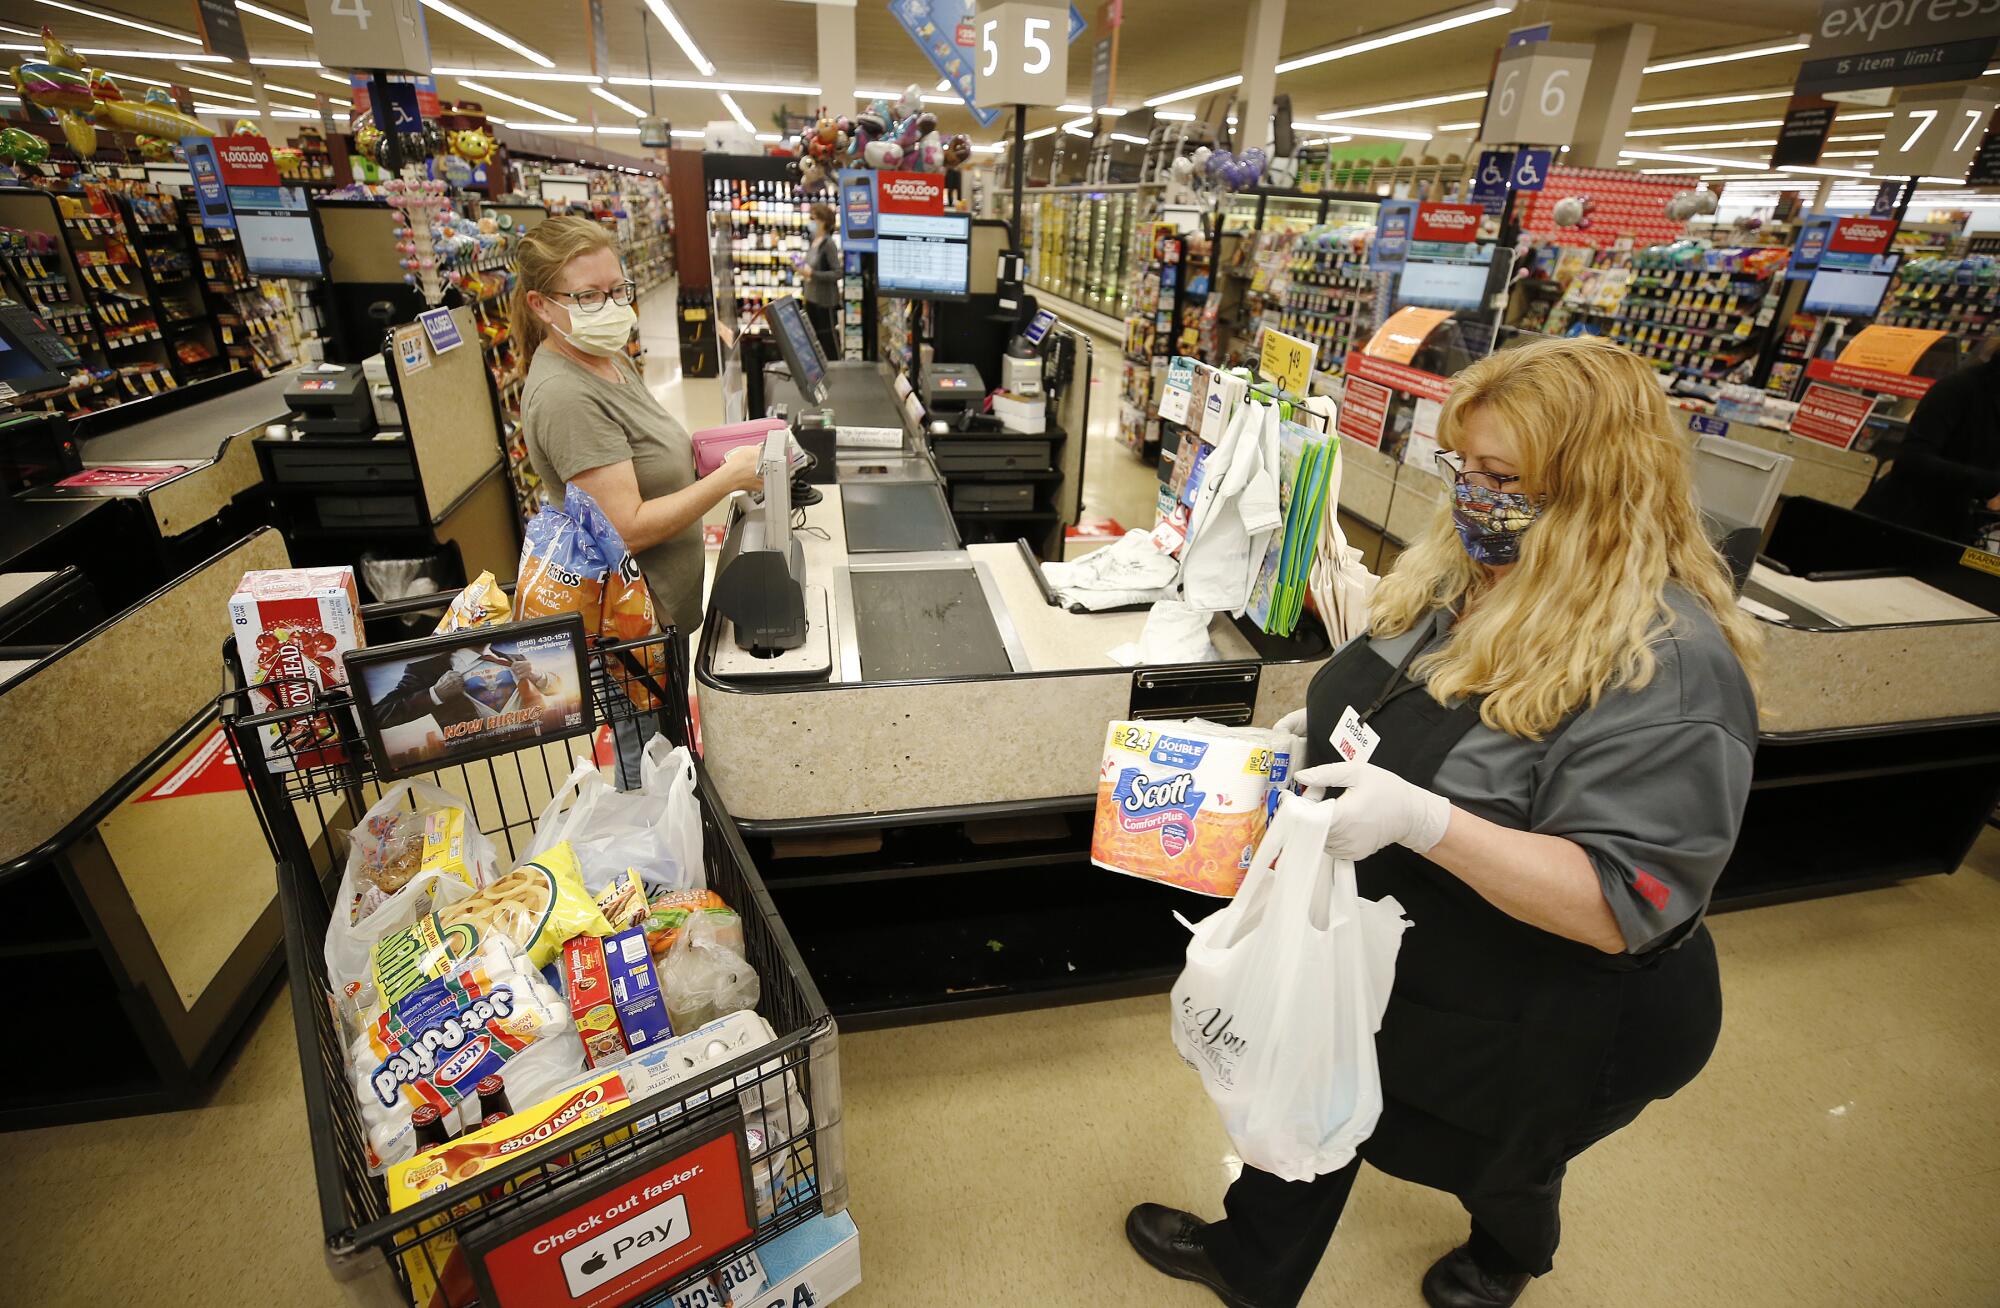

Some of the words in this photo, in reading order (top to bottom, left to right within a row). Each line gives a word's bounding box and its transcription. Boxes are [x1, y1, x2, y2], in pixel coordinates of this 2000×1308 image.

[330, 0, 372, 30] 4
[982, 19, 998, 77] 5
[1023, 17, 1051, 75] 5
[1857, 55, 1895, 71] item
[1904, 48, 1944, 67] limit
[1498, 69, 1519, 117] 6
[1540, 69, 1570, 117] 6
[1900, 109, 1938, 152] 7
[1953, 109, 1982, 152] 7
[221, 152, 269, 163] $1,000,000
[427, 314, 453, 336] CLOSED
[535, 585, 560, 599] PARTY
[535, 595, 561, 610] MUSIC
[235, 617, 248, 625] 8
[516, 637, 537, 649] (888)
[538, 632, 570, 644] 430-1571
[275, 668, 284, 687] WTER
[280, 645, 314, 727] AOWHEAD
[280, 686, 290, 708] SPRING
[443, 717, 483, 741] NOW
[486, 705, 543, 730] HIRING
[1345, 717, 1369, 748] Debbie
[1125, 727, 1152, 751] 24
[1158, 740, 1202, 757] DOUBLE
[1339, 737, 1357, 761] VONS
[1124, 772, 1194, 813] Scott
[1123, 811, 1184, 830] ComfortPlus
[423, 1004, 440, 1018] with
[438, 992, 457, 1007] fun
[386, 1023, 408, 1045] yum!
[407, 1014, 424, 1027] your
[375, 991, 512, 1104] Jet-Puffed
[449, 1044, 481, 1077] Kraft
[553, 1084, 605, 1128] CORN
[499, 1123, 553, 1154] DOGS
[532, 1213, 603, 1257] Check
[605, 1195, 640, 1220] out
[642, 1162, 704, 1201] faster.
[612, 1217, 674, 1260] Pay
